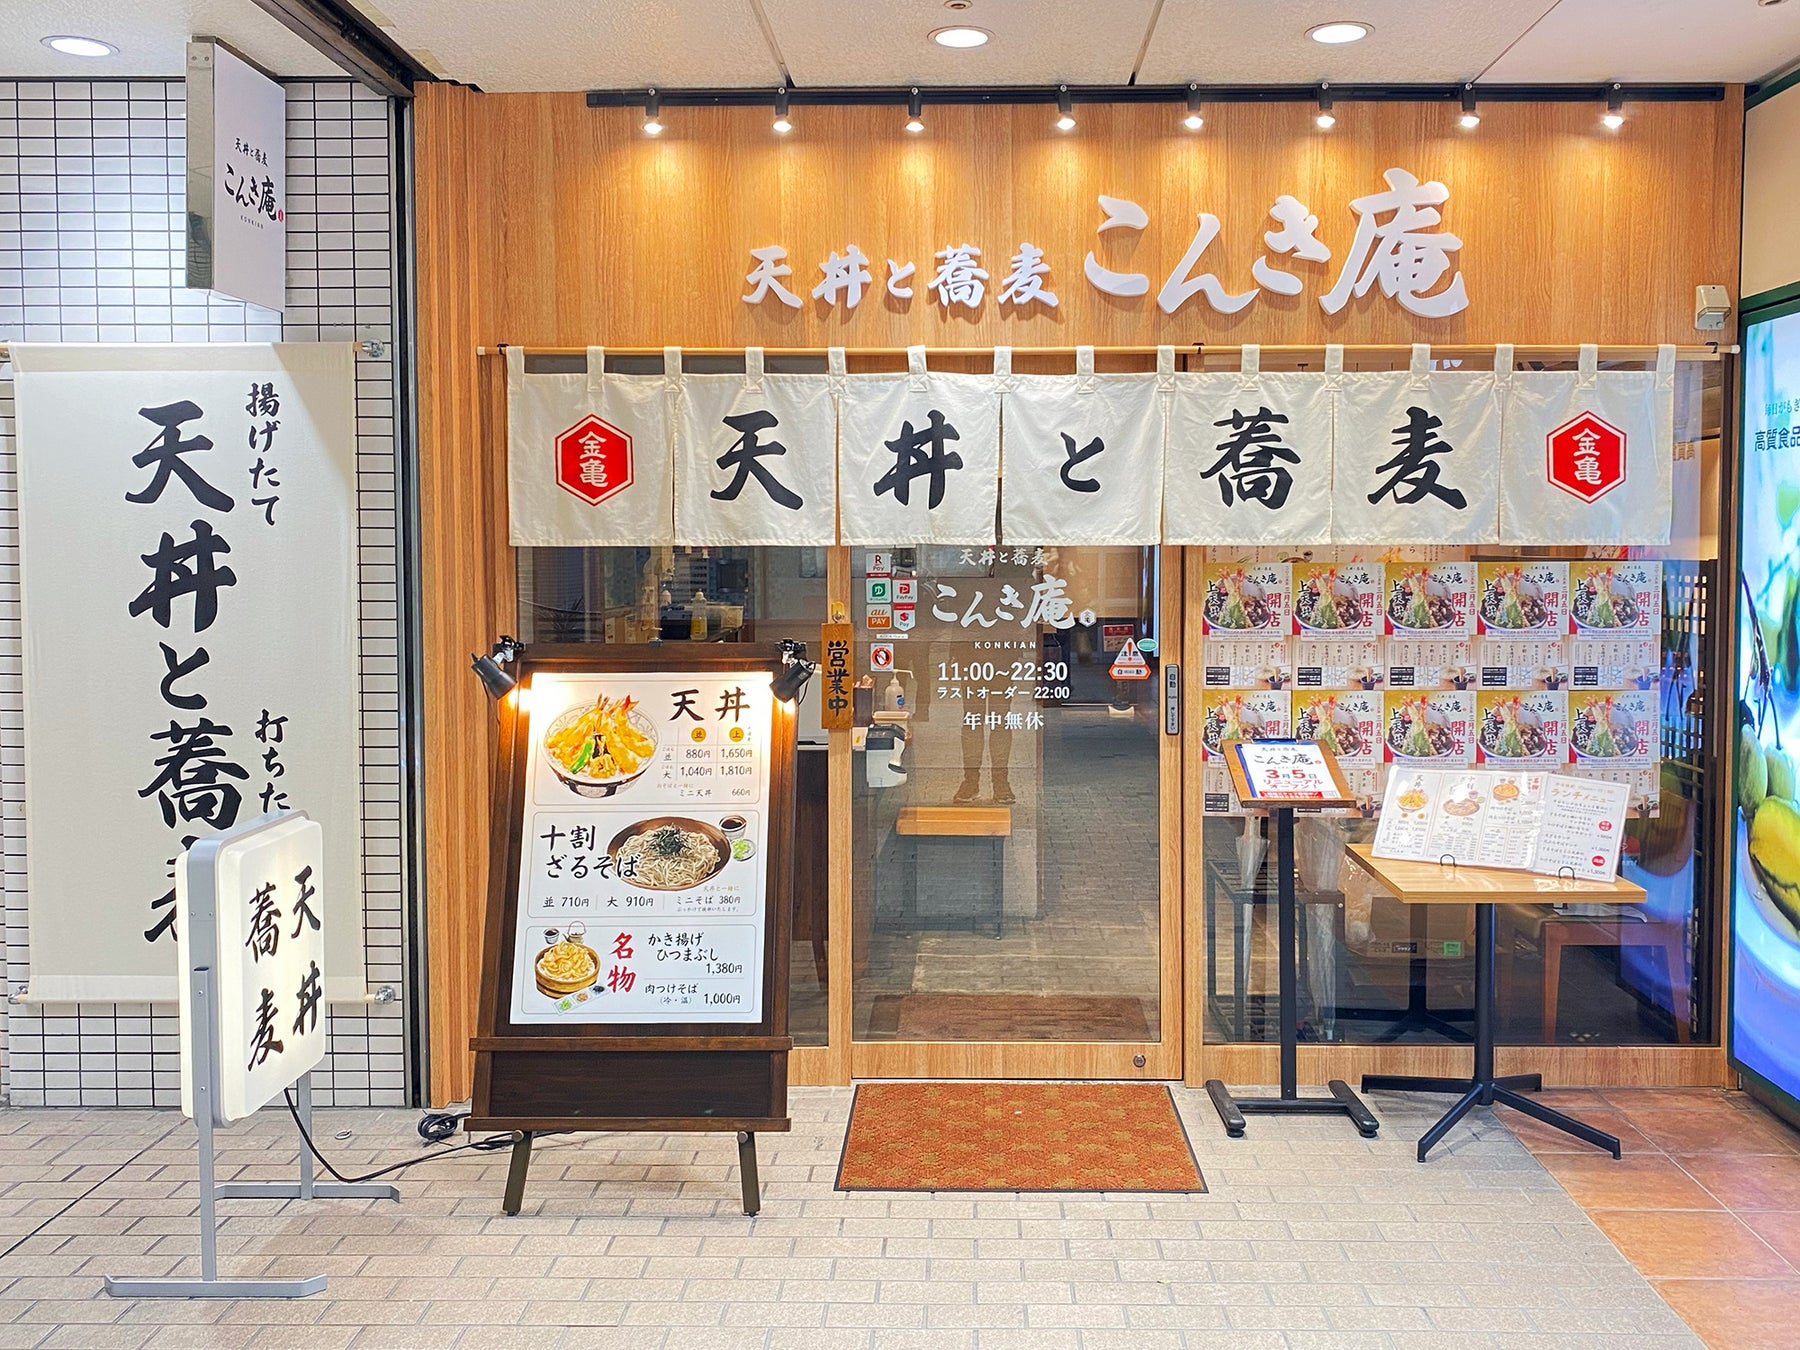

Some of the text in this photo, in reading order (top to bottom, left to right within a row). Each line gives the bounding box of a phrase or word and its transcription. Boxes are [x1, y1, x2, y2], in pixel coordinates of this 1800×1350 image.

[235, 137, 268, 167] 天丼と蕎麦
[224, 163, 277, 221] こんき庵
[741, 167, 1469, 317] 天丼と蕎麦 こんき庵
[244, 382, 283, 526] 揚げたて
[577, 430, 609, 488] 金亀
[1572, 427, 1603, 486] 金亀
[958, 548, 1049, 567] 天丼と蕎麦
[1247, 572, 1278, 585] こんき庵
[1339, 572, 1371, 585] こんき庵
[1432, 572, 1463, 585] こんき庵
[1523, 572, 1555, 585] こんき庵
[1616, 572, 1648, 585] こんき庵
[932, 573, 1077, 630] こんき庵
[1266, 592, 1282, 628] 開店
[1359, 592, 1375, 628] 開店
[1451, 592, 1467, 628] 開店
[1543, 592, 1559, 628] 開店
[1635, 592, 1651, 628] 開店
[871, 608, 887, 616] au
[871, 617, 887, 625] PAY
[974, 641, 1037, 650] KONKIAN
[826, 640, 850, 717] 営業中
[937, 661, 1069, 682] 11:00~22:30
[936, 686, 1071, 700] ラストオーダー 22:00
[668, 686, 751, 722] 天丼
[1246, 700, 1277, 713] こんき庵
[1339, 700, 1370, 713] こんき庵
[1431, 700, 1462, 713] こんき庵
[1523, 700, 1555, 713] こんき庵
[1614, 700, 1646, 713] こんき庵
[963, 711, 1045, 731] 年中無休
[1265, 720, 1280, 736] 開
[732, 730, 742, 739] 上
[1358, 720, 1373, 755] 開店
[1450, 720, 1466, 755] 開店
[1543, 720, 1559, 755] 開店
[1634, 720, 1650, 755] 開店
[254, 709, 291, 813] 打ちた
[685, 748, 711, 759] 880円
[721, 748, 753, 760] 1,650円
[1254, 753, 1313, 765] こんき庵
[663, 765, 752, 780] 大 1,040円 1,810円
[1265, 769, 1317, 779] 3月5日
[680, 788, 751, 798] ミニ天丼 660円
[1551, 788, 1616, 804] ランチメニュー
[540, 824, 597, 852] 十割
[546, 853, 642, 880] ざるそば
[542, 895, 654, 908] 並 710円 大 910円
[676, 895, 741, 905] ミニそば 380円
[648, 932, 705, 947] かき揚げ
[290, 865, 323, 1036] 天丼
[656, 948, 719, 962] ひつまぶし
[606, 932, 637, 993] 名物
[705, 962, 743, 975] 1,380円
[245, 882, 284, 1072] 蕎麦
[644, 983, 741, 1005] 肉つけそば 1,000円
